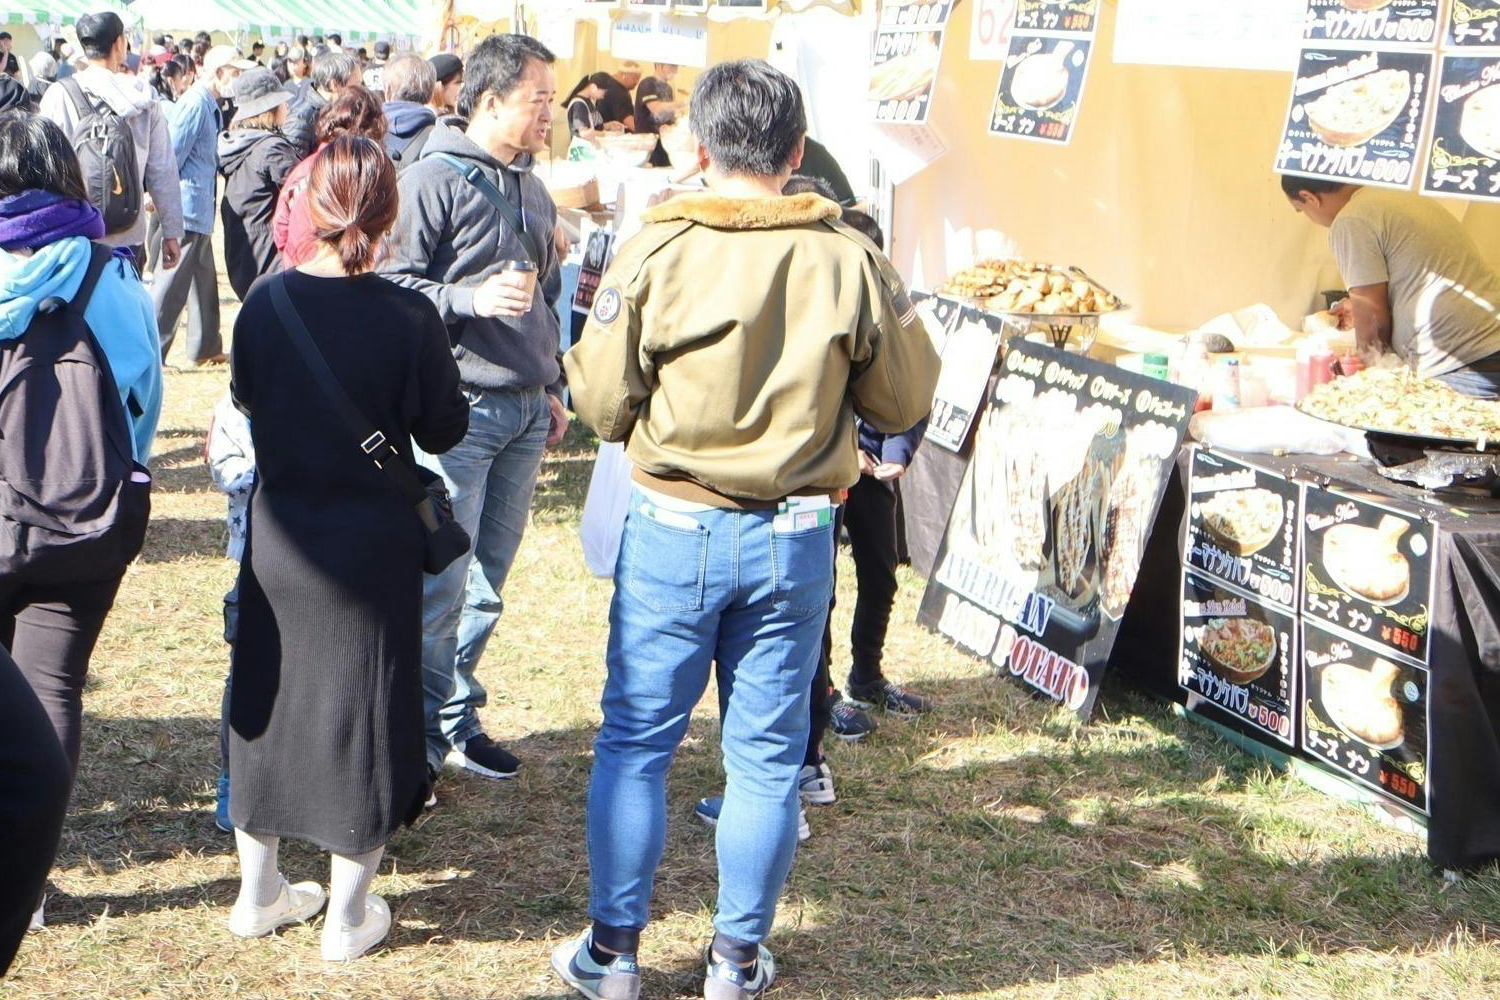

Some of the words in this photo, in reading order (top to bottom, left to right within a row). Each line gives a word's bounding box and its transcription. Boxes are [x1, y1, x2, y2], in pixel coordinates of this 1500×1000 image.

[1455, 21, 1498, 43] チーズ
[1432, 169, 1479, 191] チーズ
[1308, 593, 1339, 622] チーズ
[1348, 608, 1372, 633] ナン
[1381, 625, 1419, 651] ¥550
[992, 624, 1089, 711] POTATO
[1181, 656, 1249, 714] キーマナンケバブ
[1248, 703, 1290, 737] ¥500
[1308, 730, 1339, 760] チーズ
[1346, 750, 1370, 775] ナン
[1379, 770, 1417, 799] ¥550
